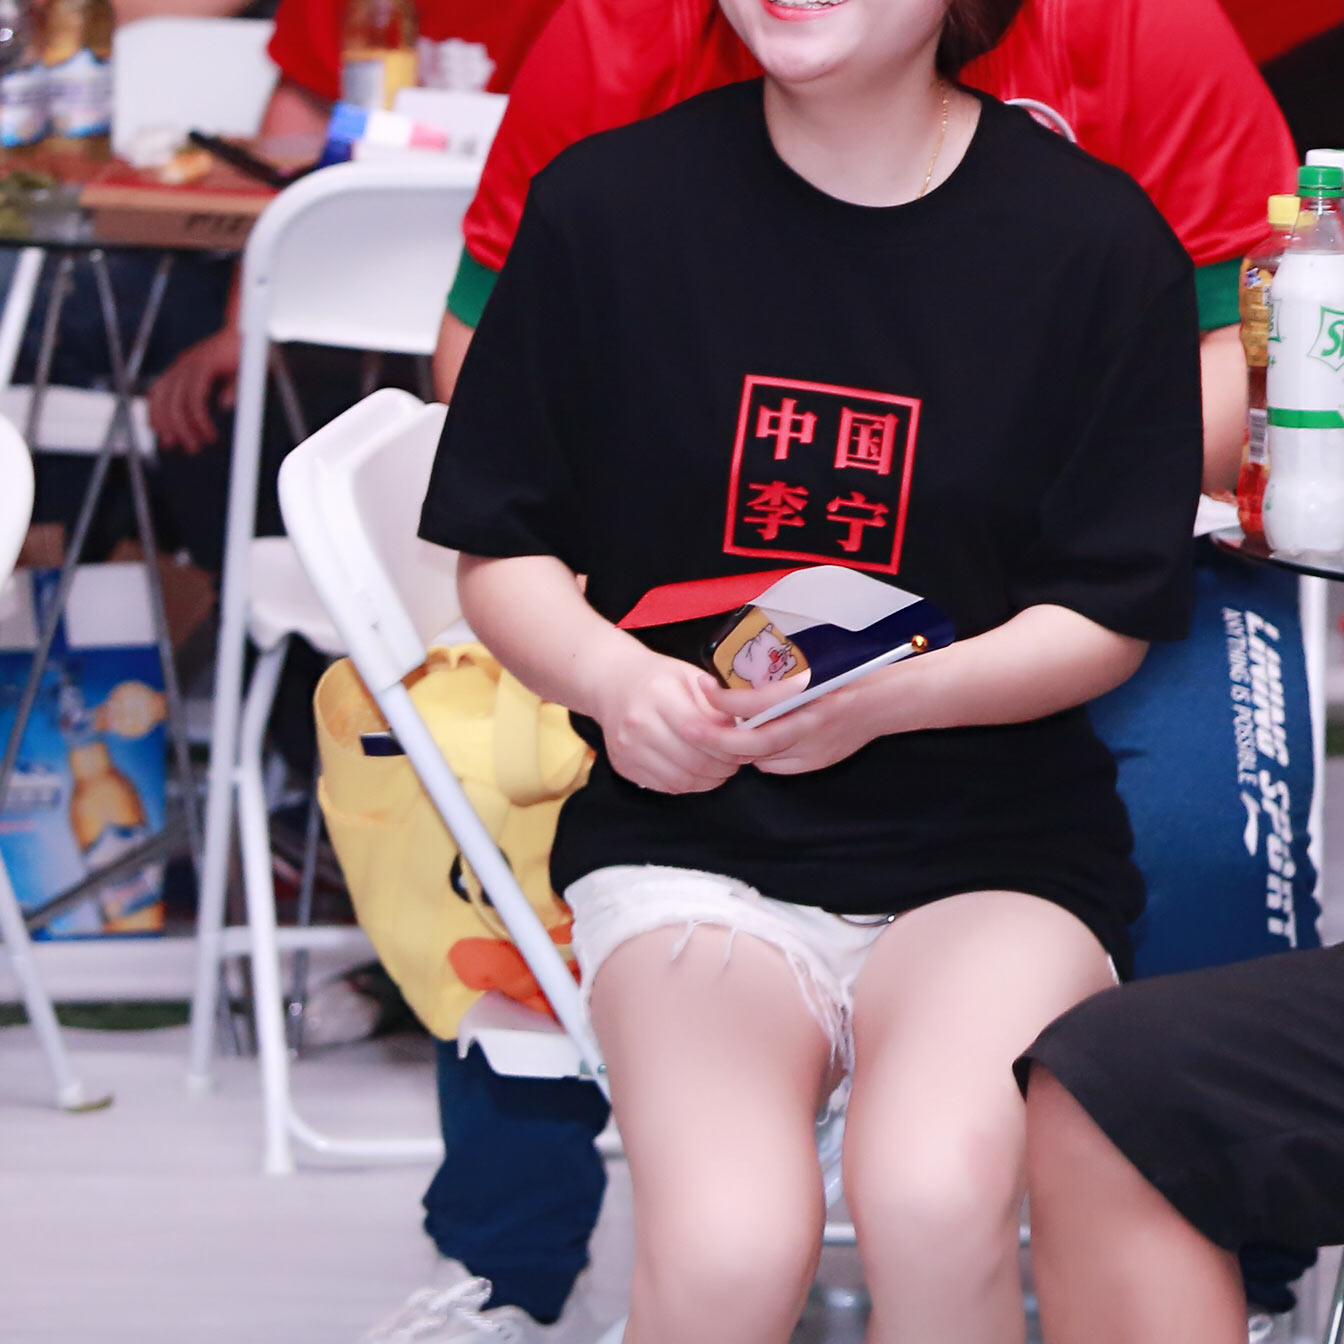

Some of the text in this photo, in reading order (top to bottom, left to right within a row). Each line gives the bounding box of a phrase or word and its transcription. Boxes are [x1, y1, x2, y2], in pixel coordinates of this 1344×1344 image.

[756, 397, 899, 476] 中国
[743, 481, 890, 553] 李宁
[1222, 607, 1250, 683] ANYTHING
[1233, 703, 1258, 785] POSSIBLE
[1259, 769, 1298, 949] SPORT
